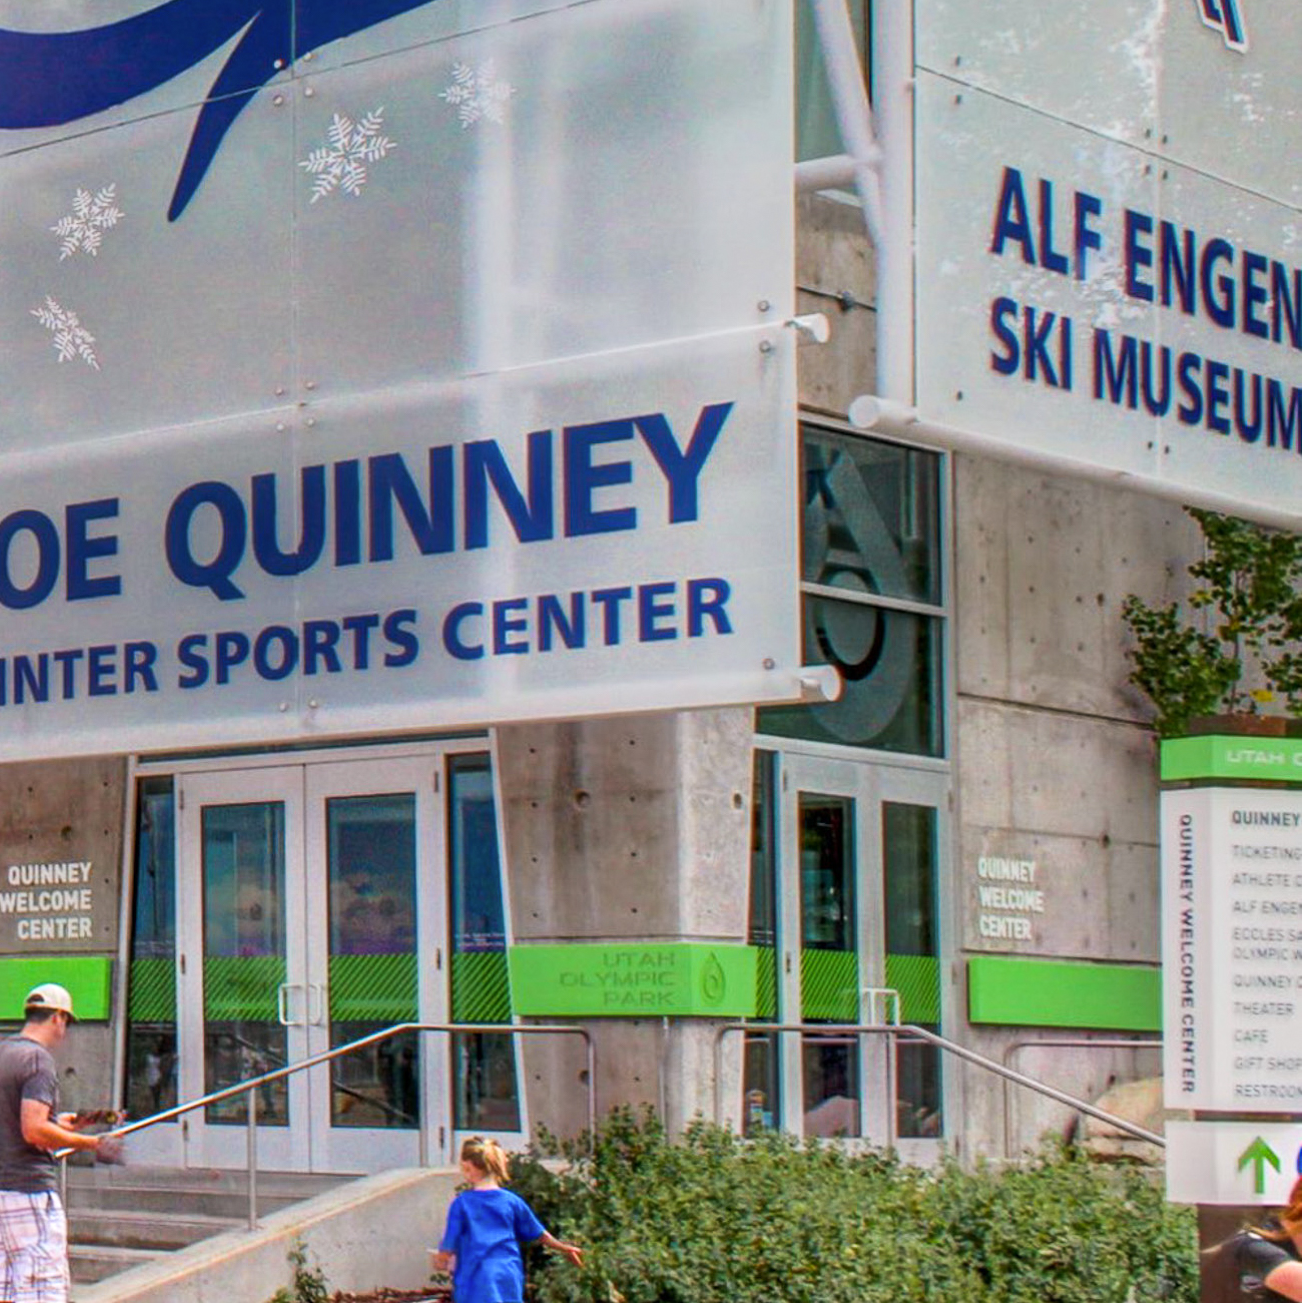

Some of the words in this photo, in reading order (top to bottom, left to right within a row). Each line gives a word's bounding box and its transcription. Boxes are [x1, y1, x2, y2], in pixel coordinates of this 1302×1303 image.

[989, 164, 1102, 281] ALF
[1124, 208, 1302, 350] ENGEN
[989, 296, 1072, 392] SKI
[1093, 327, 1302, 455] MUSEUM
[164, 401, 735, 601] QUINNEY
[178, 609, 420, 689] SPORTS
[442, 577, 734, 661] CENTER
[1226, 750, 1285, 765] UTAH
[1232, 810, 1301, 827] QUINNEY
[978, 857, 1035, 882] QUINNEY
[1180, 814, 1194, 902] QUINNEY
[8, 862, 92, 886] QUINNEY
[1233, 872, 1291, 887] ATHLETE
[979, 886, 1045, 913] WELCOME
[1233, 900, 1257, 914] ALF
[17, 917, 92, 940] CENTER
[980, 915, 1032, 940] CENTER
[1233, 927, 1285, 942] ECCLES
[603, 952, 675, 968] UTAH
[1180, 909, 1194, 1008] WELCOME
[559, 971, 675, 988] OLYMPIC
[603, 990, 675, 1007] PARK
[1233, 1001, 1294, 1016] THEATER
[1234, 1029, 1268, 1043] CAFE
[1181, 1014, 1195, 1093] CENTER
[1234, 1056, 1263, 1070] GIFT
